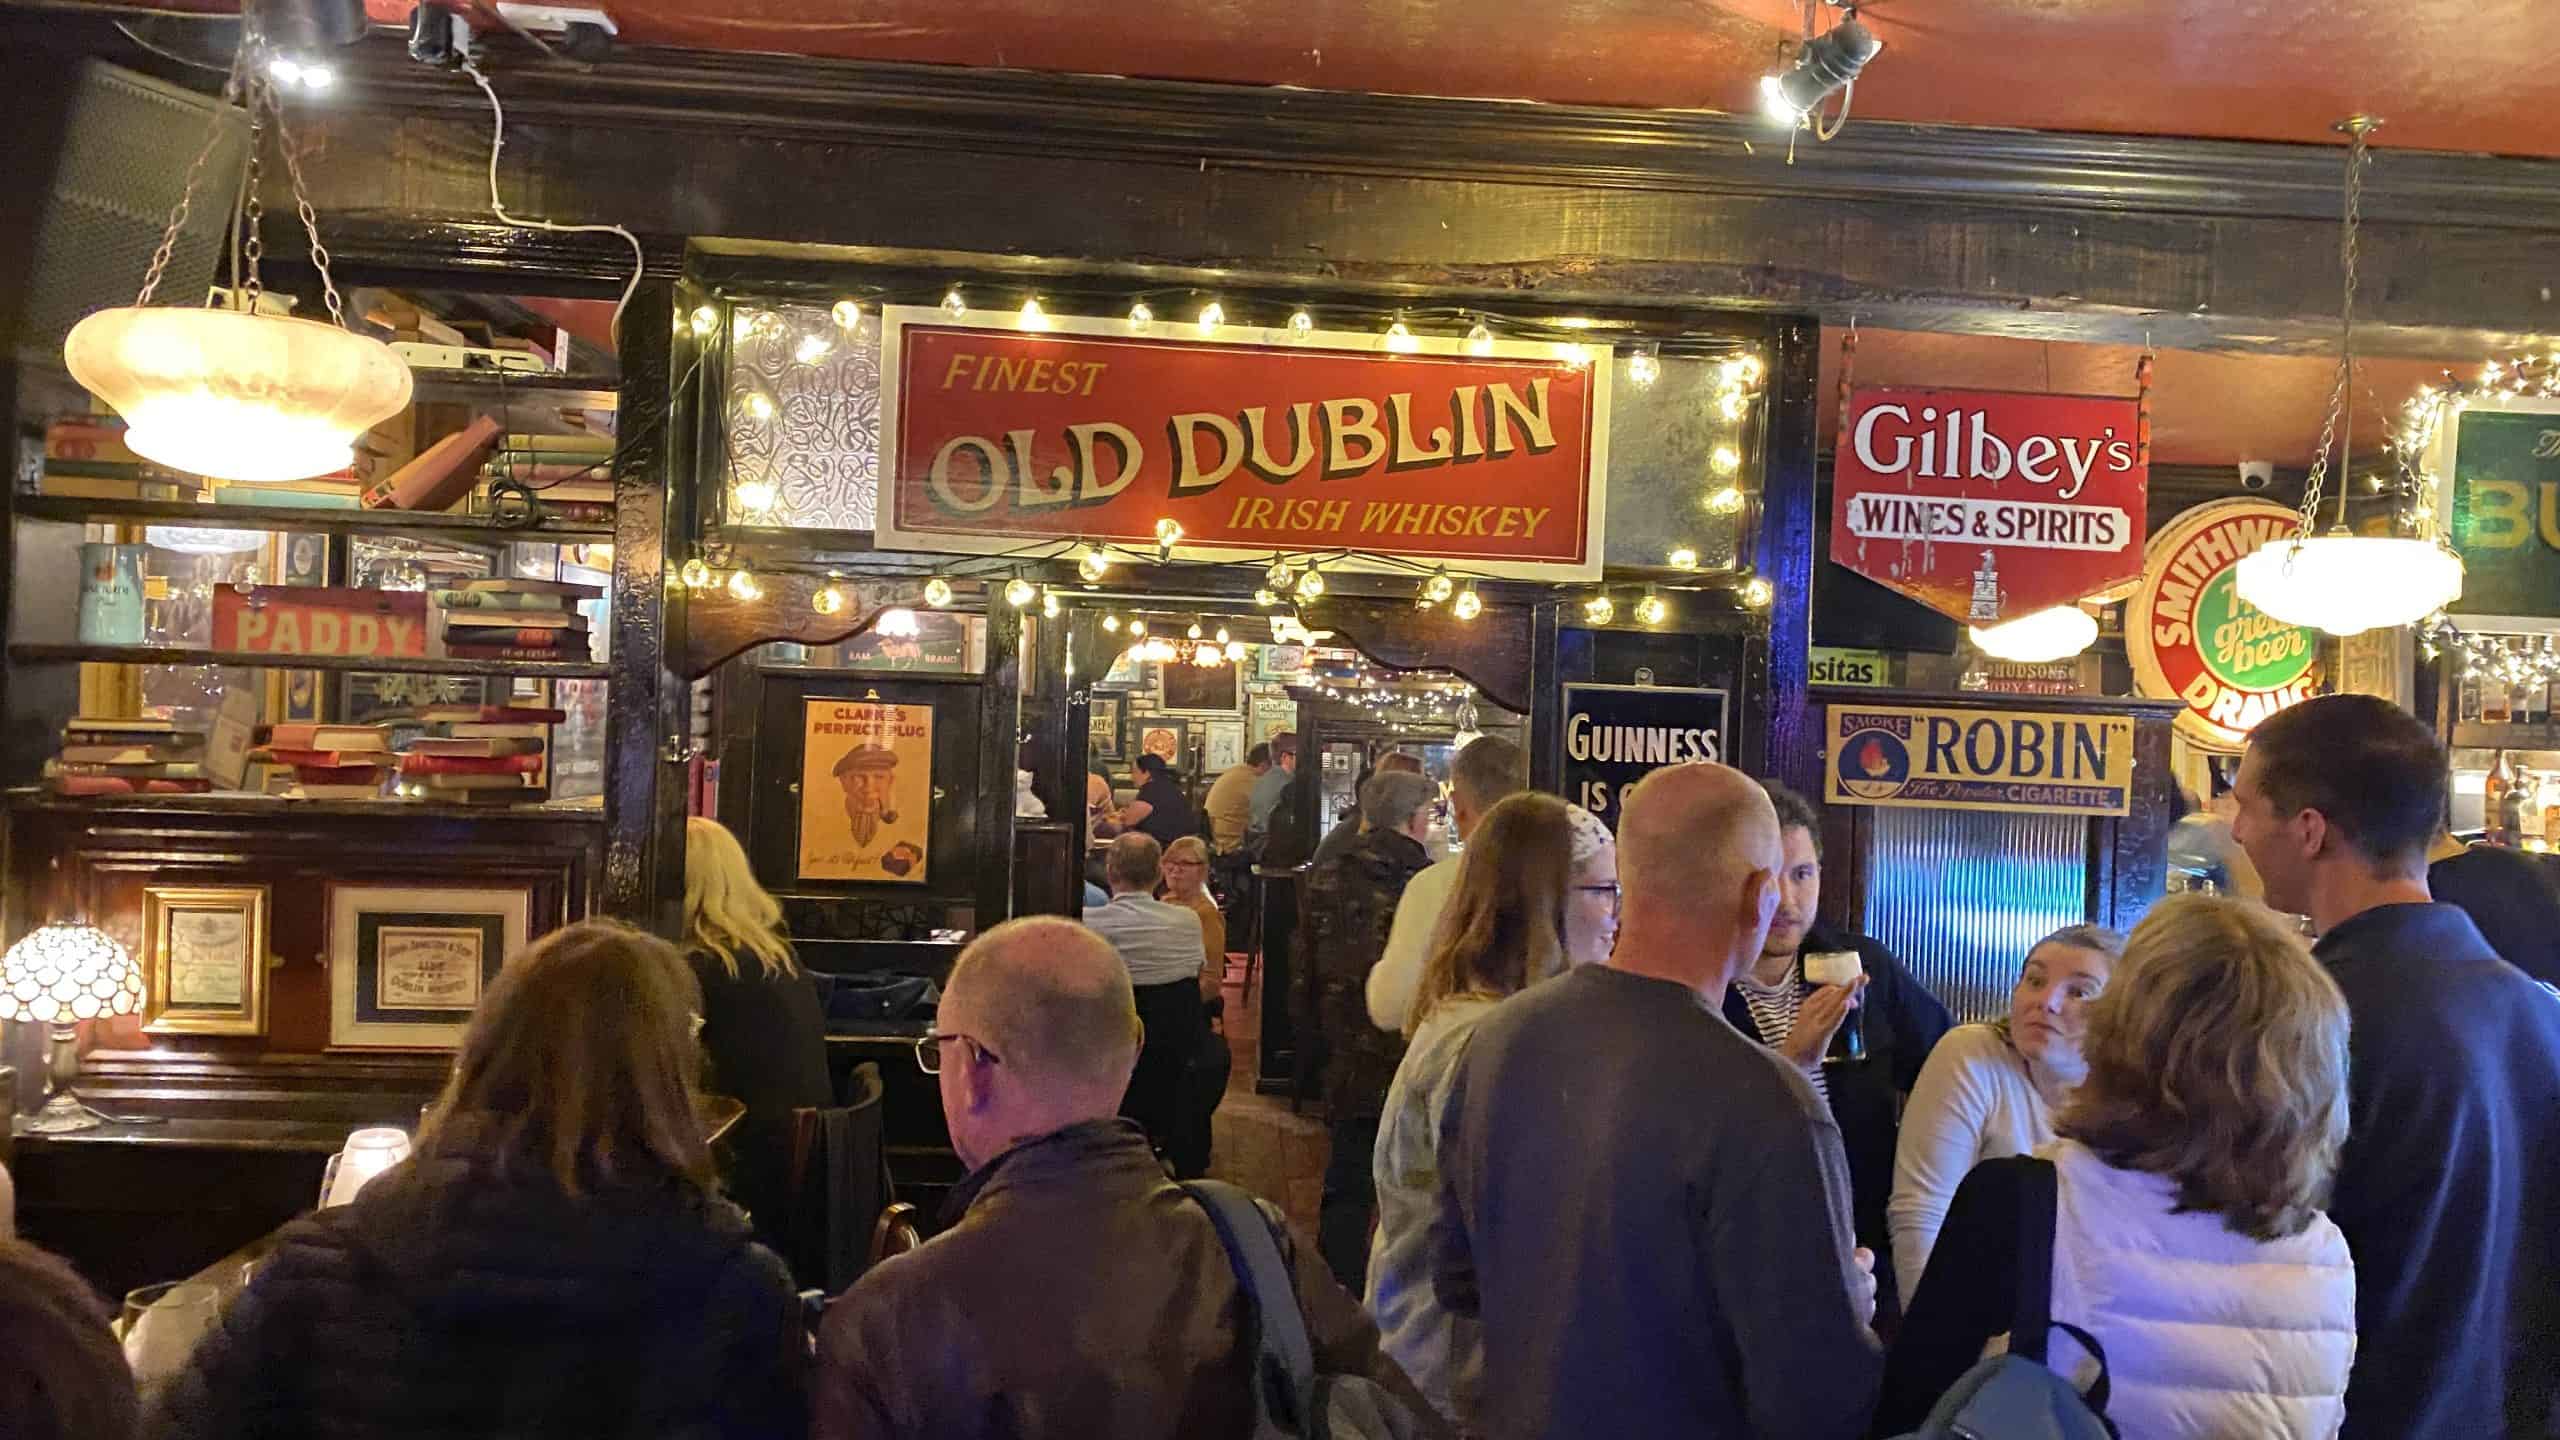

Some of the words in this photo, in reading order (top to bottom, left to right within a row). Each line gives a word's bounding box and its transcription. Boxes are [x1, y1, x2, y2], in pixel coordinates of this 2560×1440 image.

[942, 353, 1108, 396] FINEST
[928, 421, 1145, 514] OLD
[1168, 377, 1558, 498] DUBLIN
[1853, 403, 2133, 500] Gilbey's
[1227, 496, 1351, 533] IRISH
[1359, 502, 1550, 539] WHISKEY
[1861, 498, 1965, 536] WINES
[1972, 510, 1990, 537] &
[1995, 506, 2117, 544] SPIRITS
[236, 609, 417, 657] PADDY
[2233, 631, 2307, 674] beer
[813, 722, 881, 736] PERFECT
[1567, 712, 1719, 763] GUINNESS
[1842, 714, 1909, 738] SMOKE
[1581, 781, 1608, 812] IS
